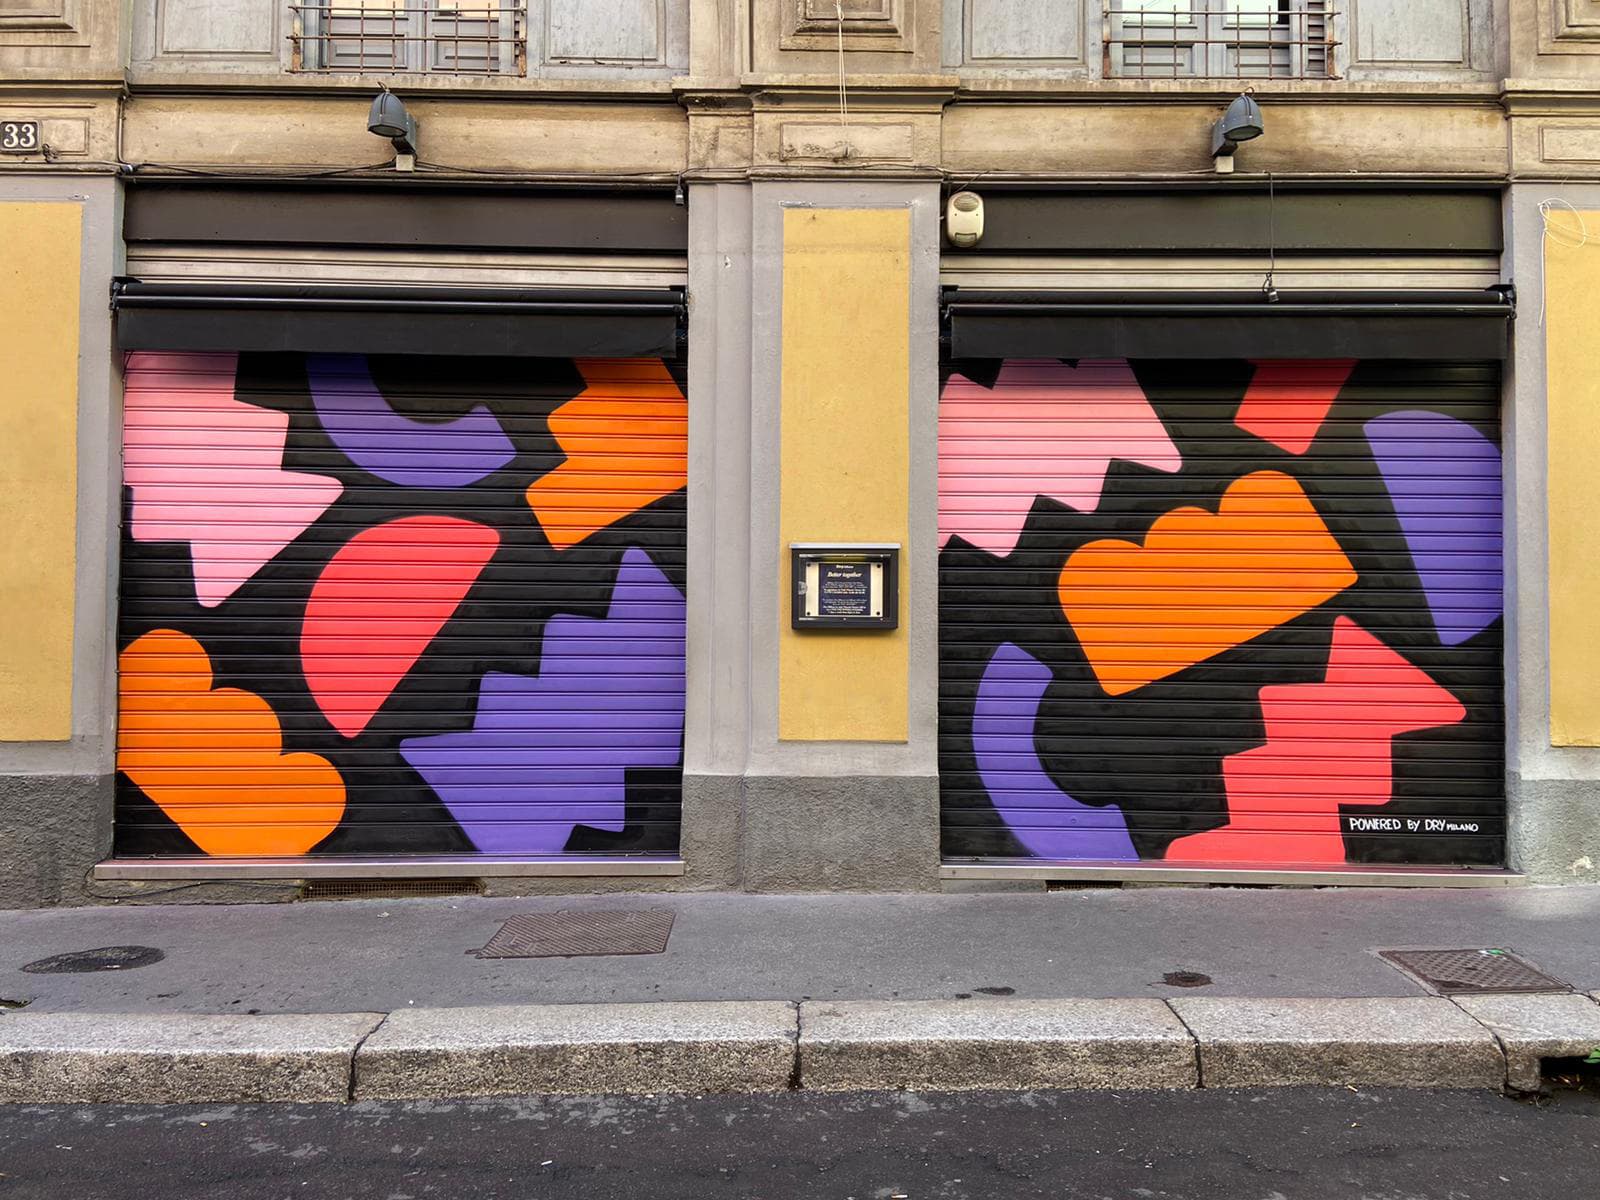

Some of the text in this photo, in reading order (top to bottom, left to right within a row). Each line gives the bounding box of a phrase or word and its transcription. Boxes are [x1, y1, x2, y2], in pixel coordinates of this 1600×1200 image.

[3, 123, 35, 148] 33
[1349, 817, 1402, 831] POWERED
[1425, 818, 1446, 832] DRY
[1446, 823, 1479, 833] MILANO
